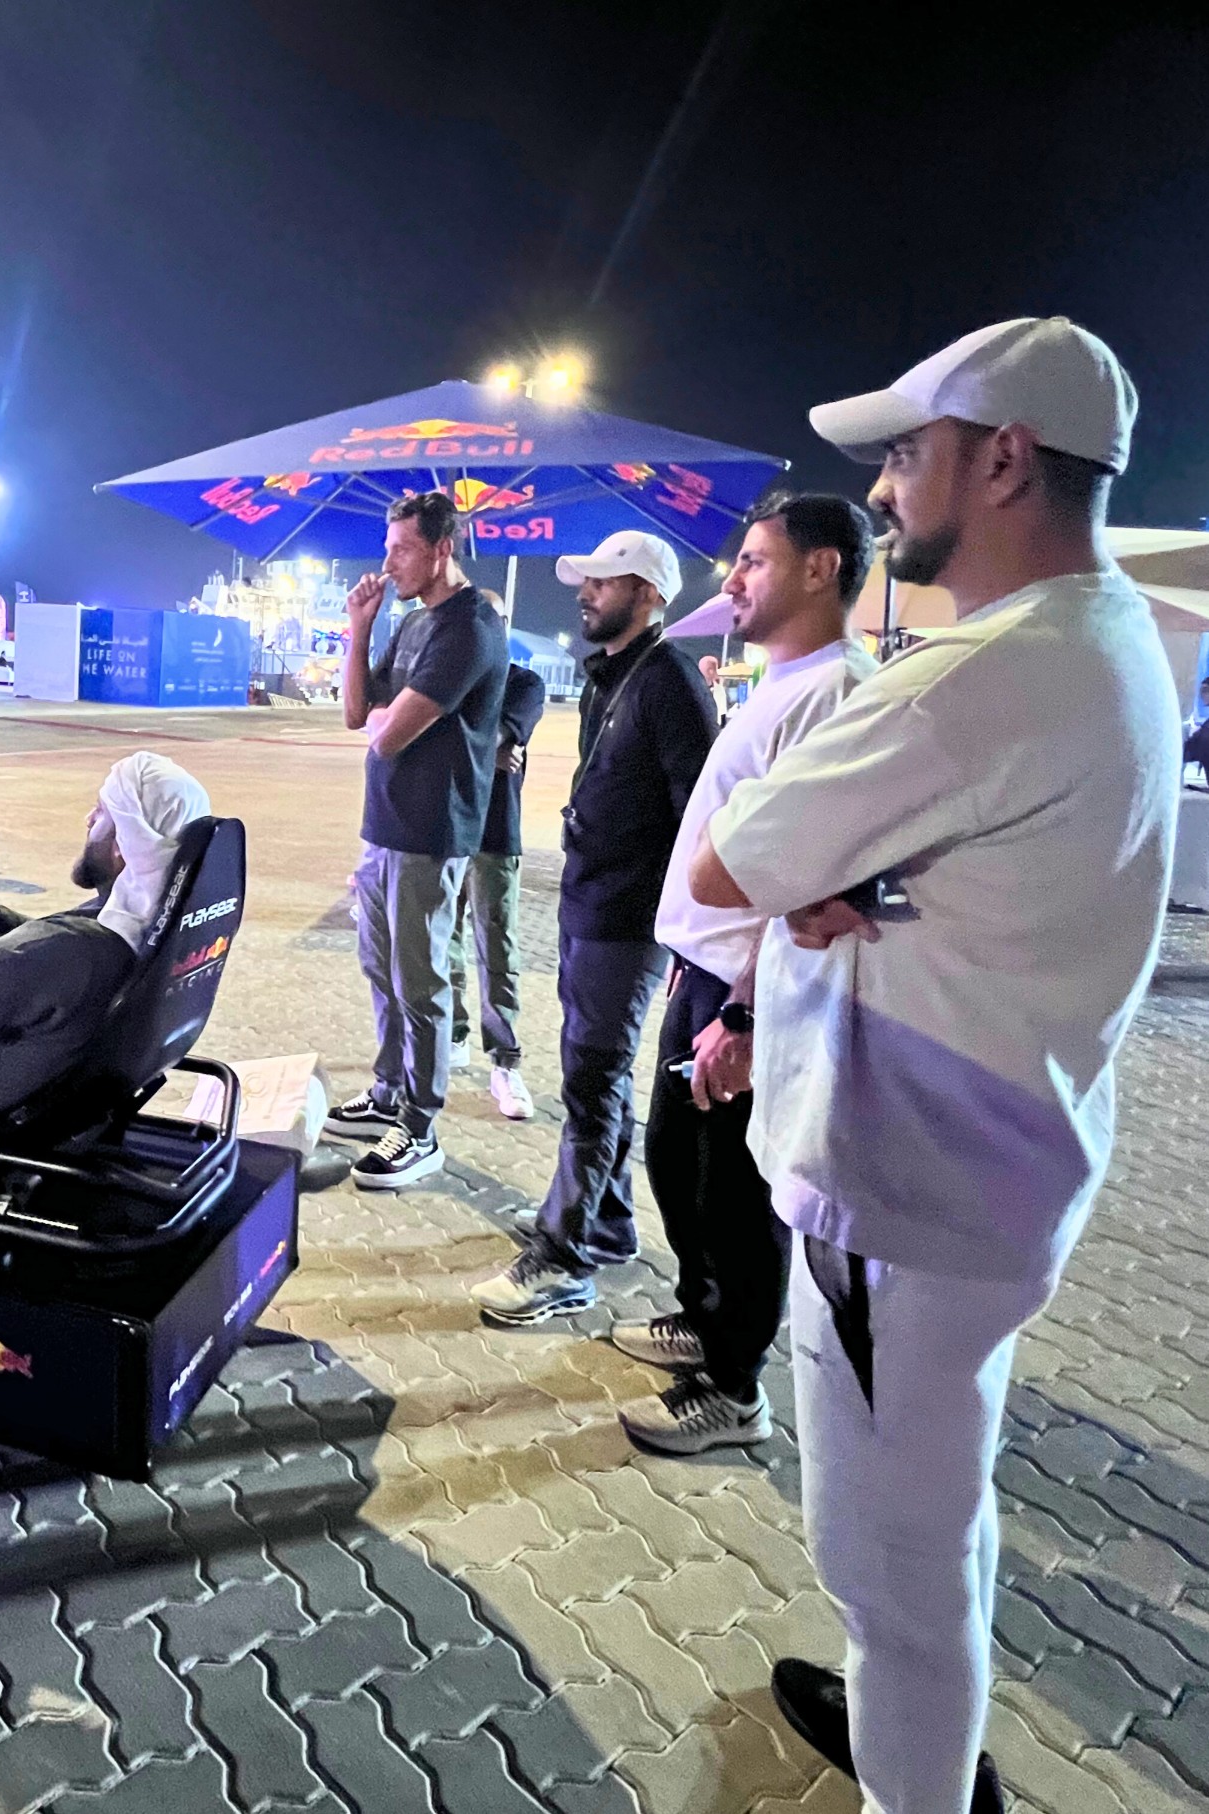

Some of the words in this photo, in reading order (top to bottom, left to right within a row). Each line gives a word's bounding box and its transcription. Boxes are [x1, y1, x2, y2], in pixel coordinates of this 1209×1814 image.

[308, 440, 419, 464] Red
[424, 440, 534, 457] Bull
[87, 648, 112, 662] LIFE
[118, 650, 136, 663] ON
[82, 663, 98, 675] HE
[103, 664, 147, 678] WATER
